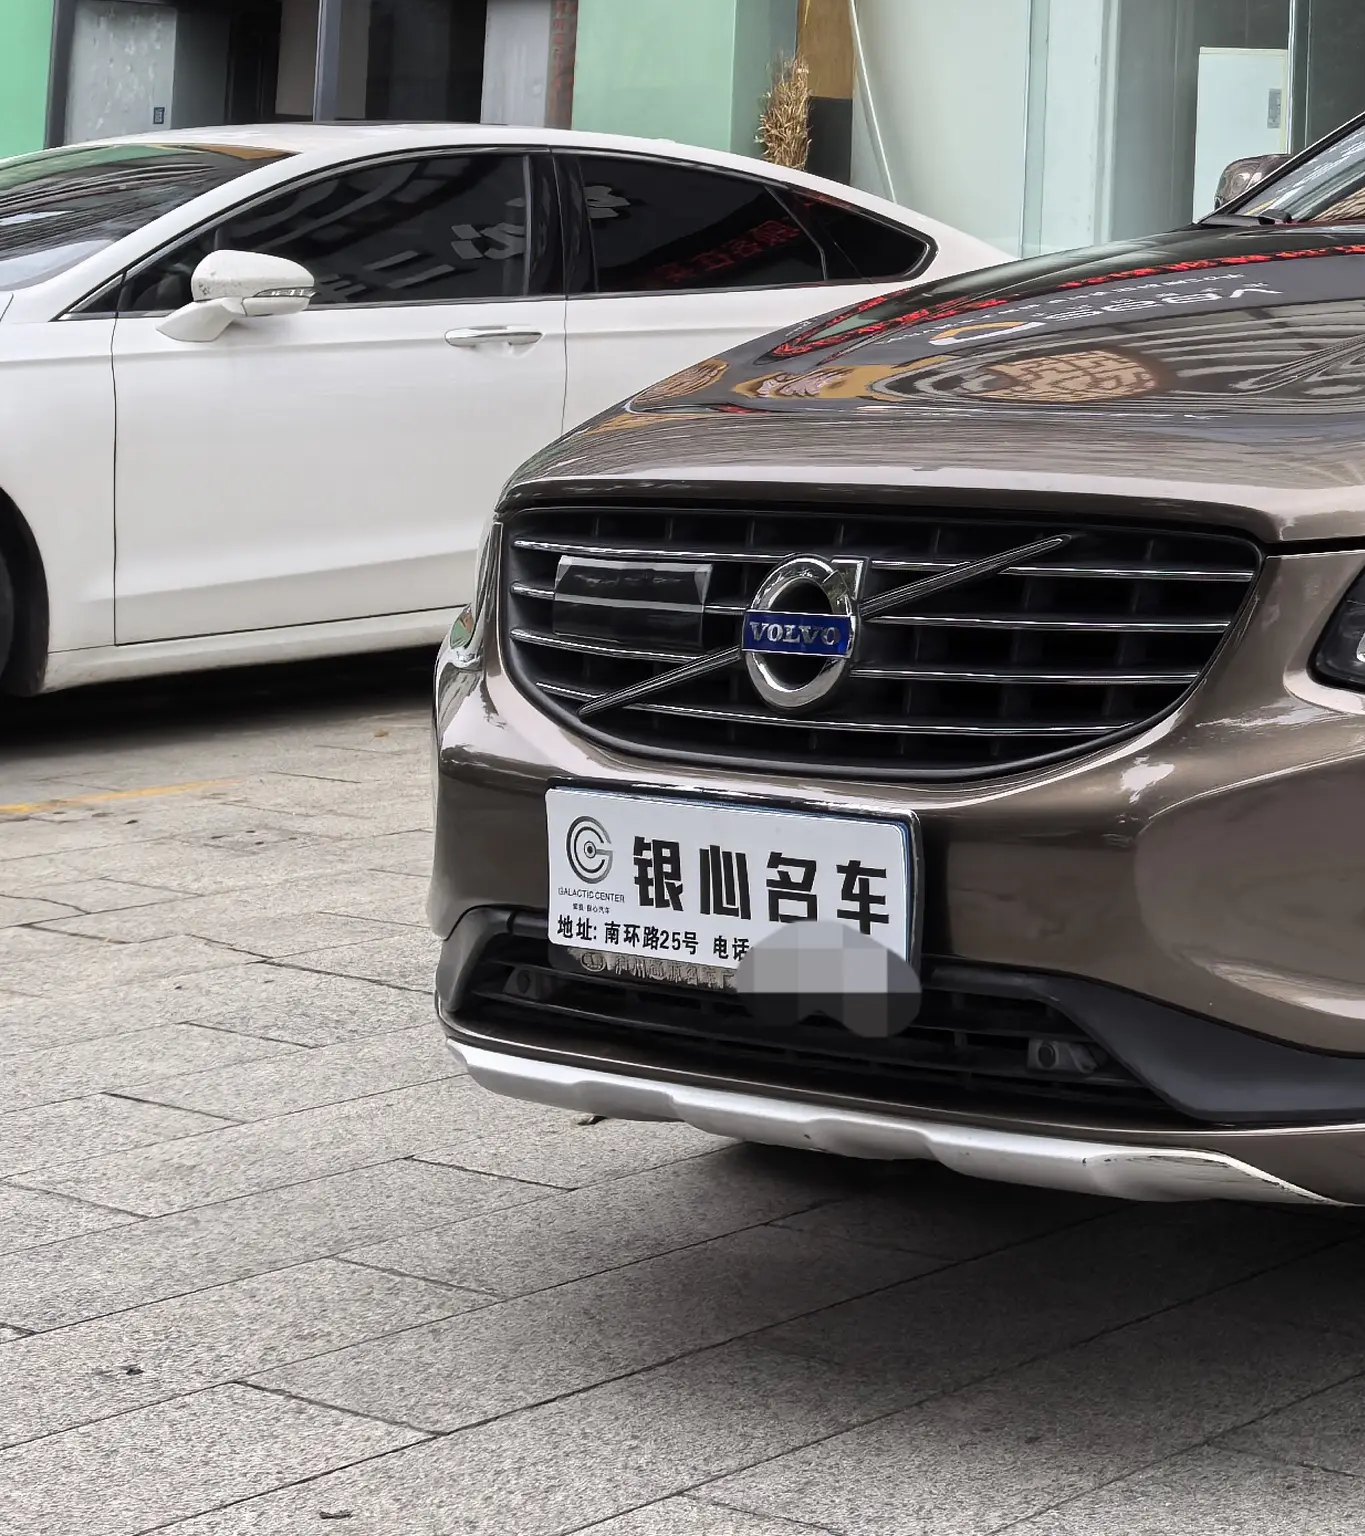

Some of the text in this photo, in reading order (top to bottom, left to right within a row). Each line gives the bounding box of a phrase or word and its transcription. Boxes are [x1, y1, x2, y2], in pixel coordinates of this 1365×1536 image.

[749, 620, 840, 646] VOLVO
[633, 835, 890, 936] 银心名车
